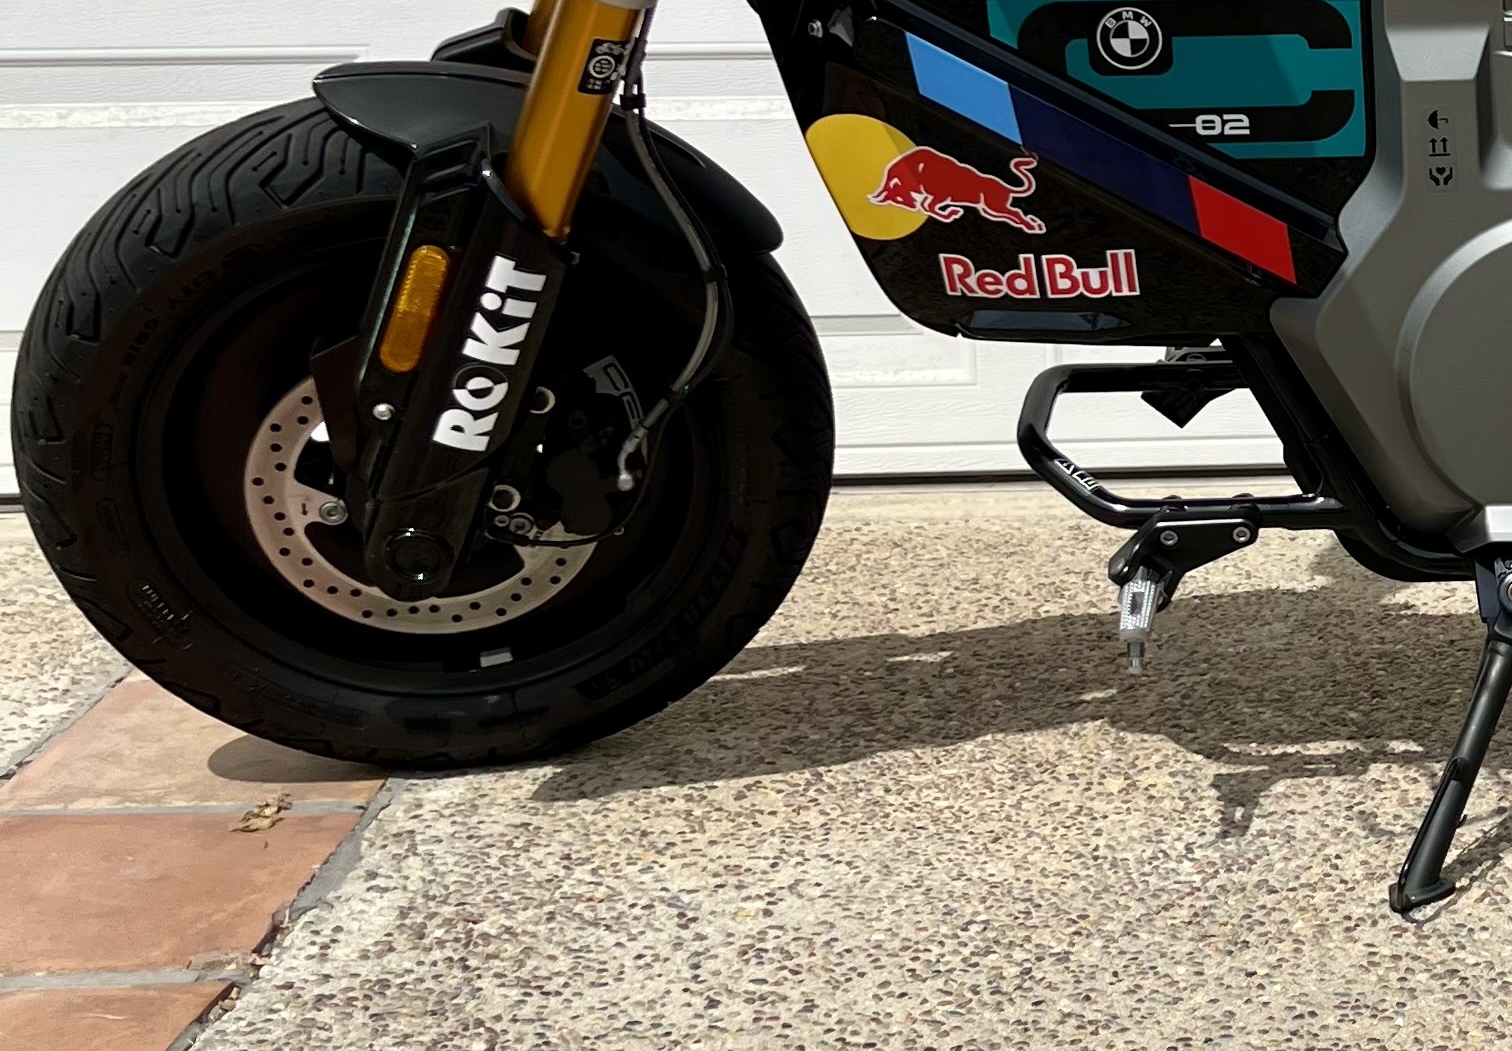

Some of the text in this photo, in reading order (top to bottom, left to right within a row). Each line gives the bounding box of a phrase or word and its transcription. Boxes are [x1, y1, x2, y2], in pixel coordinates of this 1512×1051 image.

[1104, 10, 1152, 29] BMW
[939, 249, 1140, 299] Red Bull
